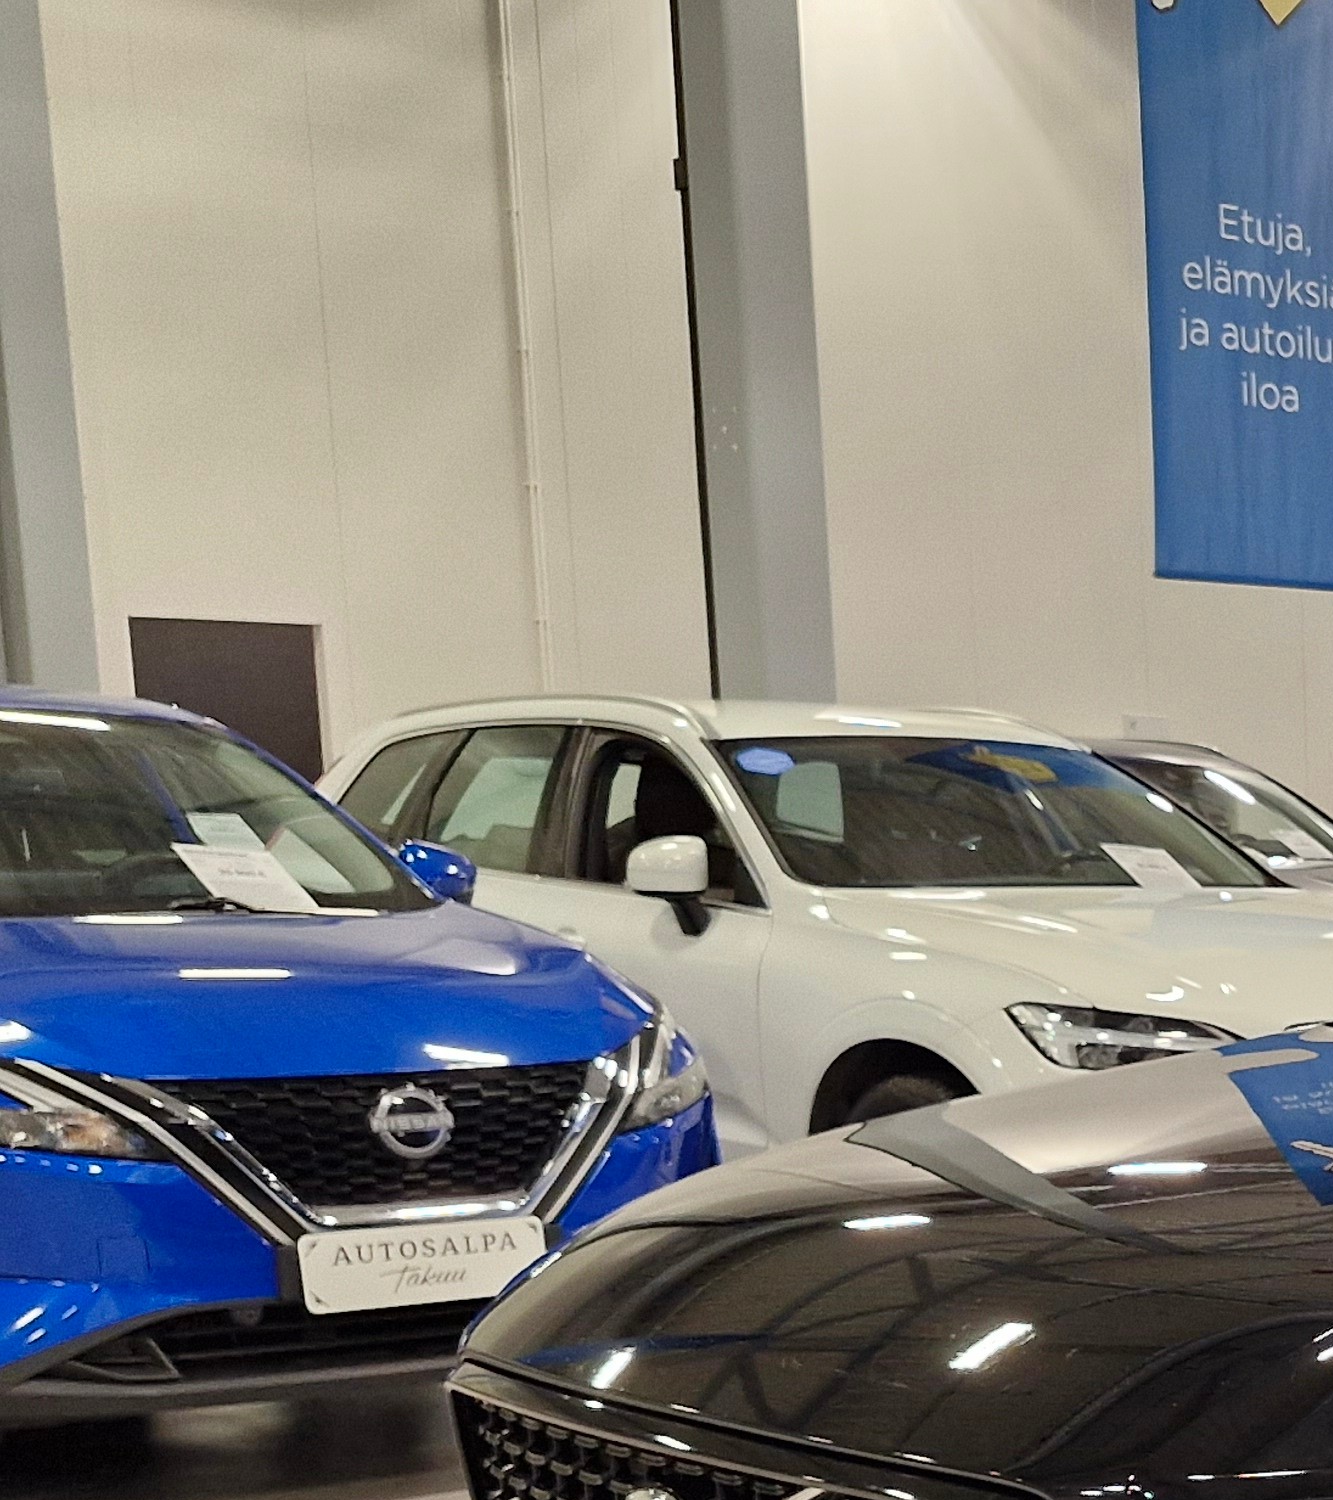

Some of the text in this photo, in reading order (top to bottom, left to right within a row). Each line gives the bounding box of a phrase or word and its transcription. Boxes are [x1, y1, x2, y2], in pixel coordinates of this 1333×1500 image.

[1218, 203, 1312, 257] Etuja,
[1179, 307, 1210, 350] ja
[1241, 371, 1300, 413] iloa
[333, 1232, 517, 1266] AUTOSALPA
[379, 1262, 467, 1294] Takuu
